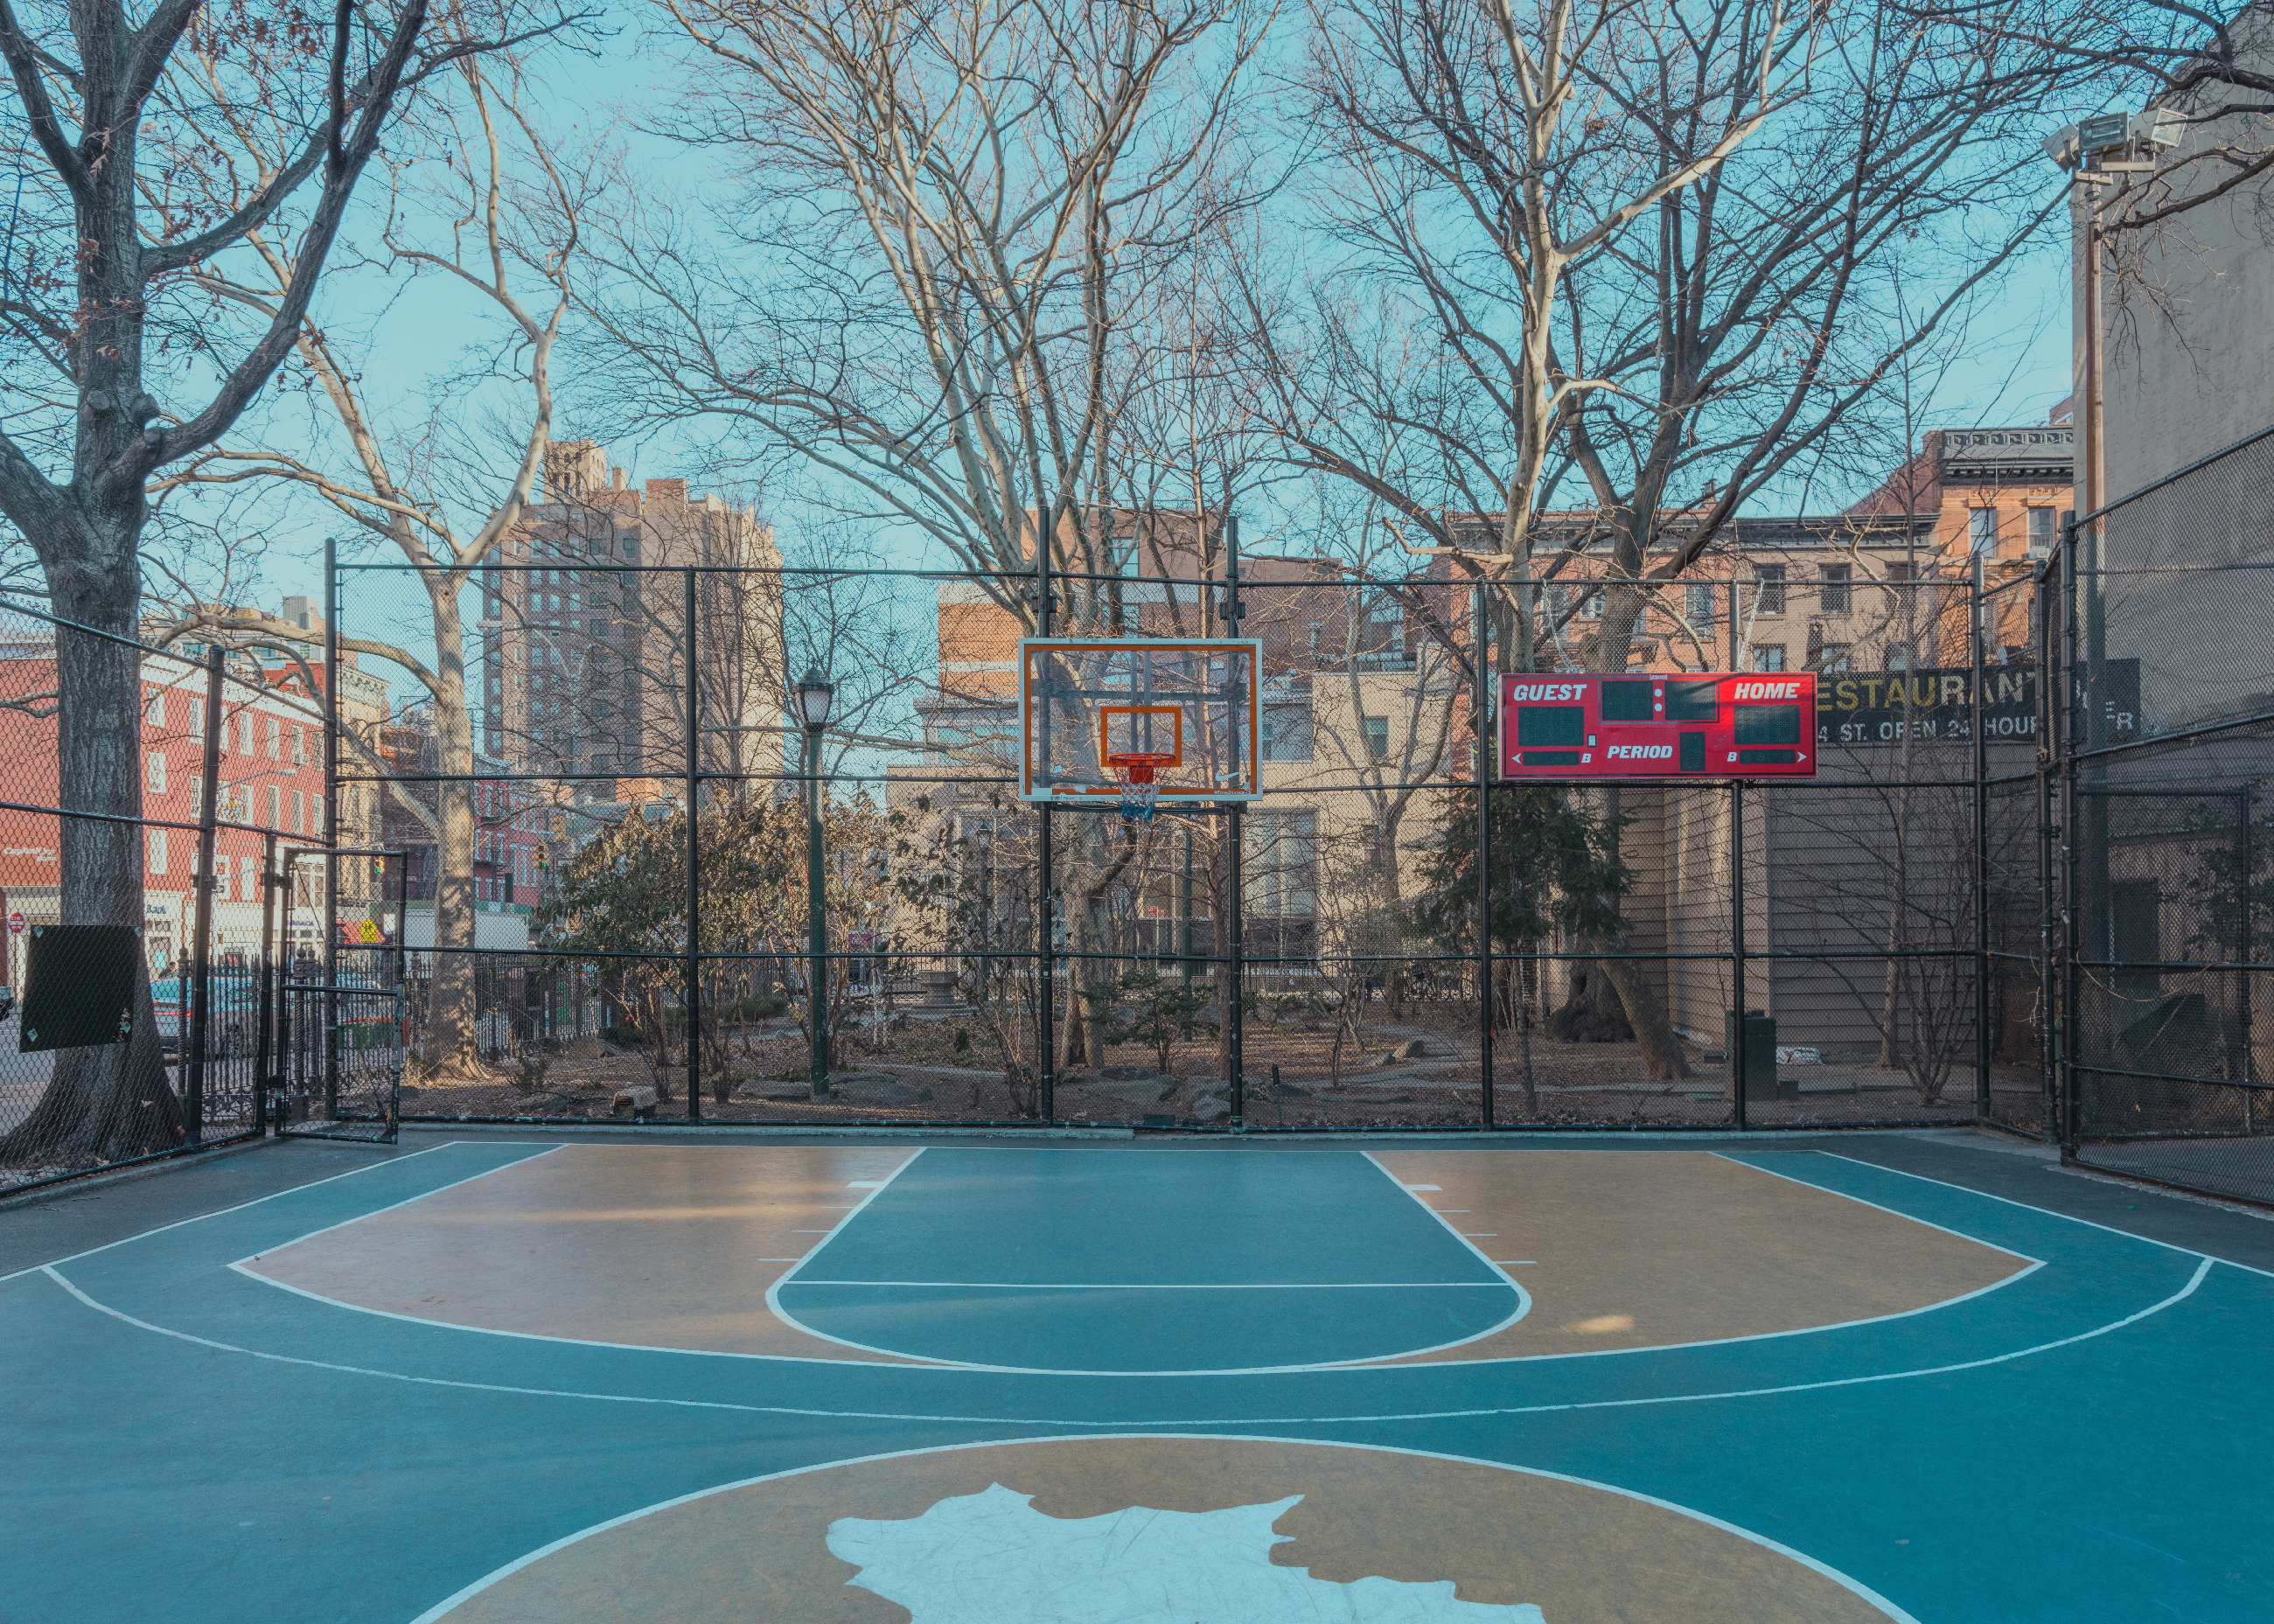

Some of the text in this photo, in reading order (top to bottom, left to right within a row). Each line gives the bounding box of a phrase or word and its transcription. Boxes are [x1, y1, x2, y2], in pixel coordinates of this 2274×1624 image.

[1513, 684, 1587, 701] GUEST
[1733, 682, 1801, 700] HOME
[1817, 672, 2037, 711] ESTAURAN
[1840, 723, 1867, 742] ST.
[1880, 720, 1936, 740] OPEN
[1580, 753, 1592, 763] B
[1607, 745, 1673, 759] PERIOD
[1726, 751, 1738, 763] B
